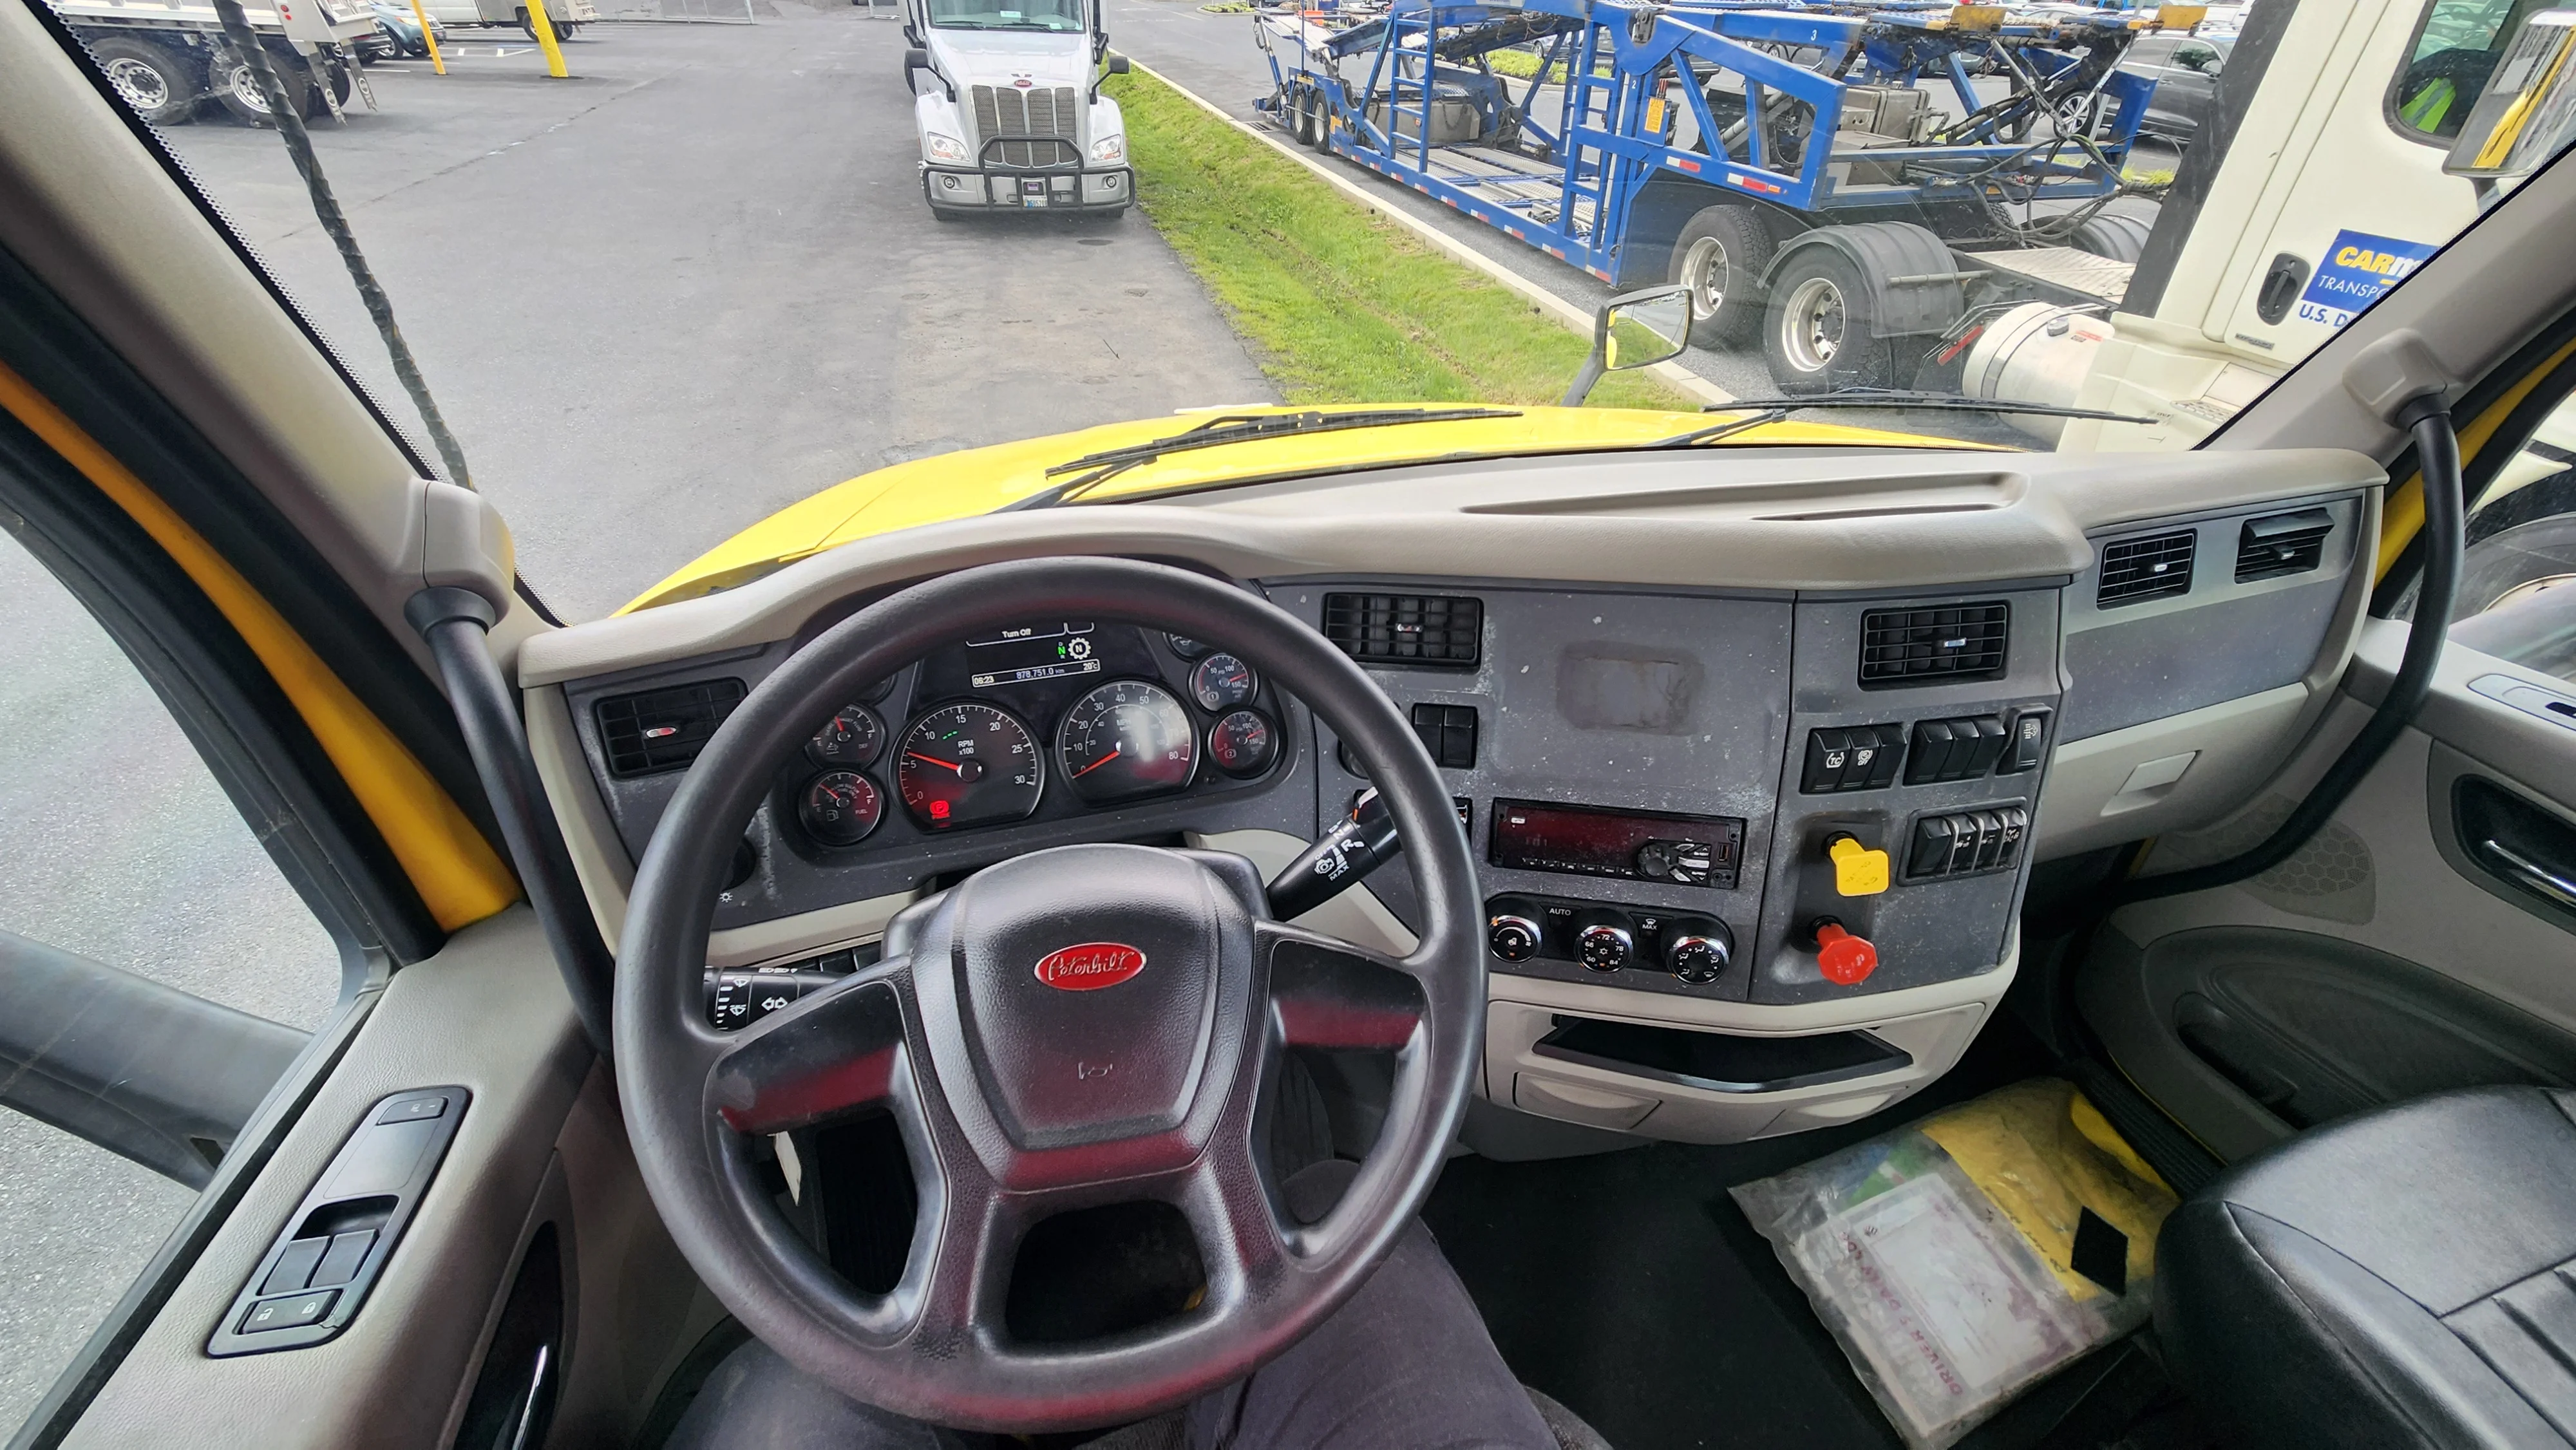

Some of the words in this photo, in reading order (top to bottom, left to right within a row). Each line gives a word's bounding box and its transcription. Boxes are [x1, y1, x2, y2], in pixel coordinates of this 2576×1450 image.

[1810, 30, 1817, 41] 3
[1631, 80, 1636, 89] 2
[2299, 305, 2327, 324] U.S.
[1058, 646, 1066, 655] N
[1075, 645, 1083, 653] N
[974, 676, 994, 685] 06:23
[1139, 696, 1150, 704] 50
[1094, 702, 1104, 711] 30
[1159, 709, 1169, 717] 60
[990, 722, 1000, 731] 20
[1078, 720, 1088, 730] 20
[925, 731, 935, 740] 10
[958, 739, 974, 748] RPM
[1074, 742, 1083, 751] 10
[1012, 744, 1023, 753] 25
[1169, 751, 1179, 760] 80
[1014, 775, 1025, 784] 30
[917, 791, 923, 799] 0
[1333, 829, 1345, 840] N
[1340, 839, 1354, 852] R
[1329, 865, 1350, 881] MAX
[1549, 908, 1571, 916] AUTO
[1047, 951, 1135, 981] Peterbilt
[1898, 1313, 1965, 1398] DRIVERS
